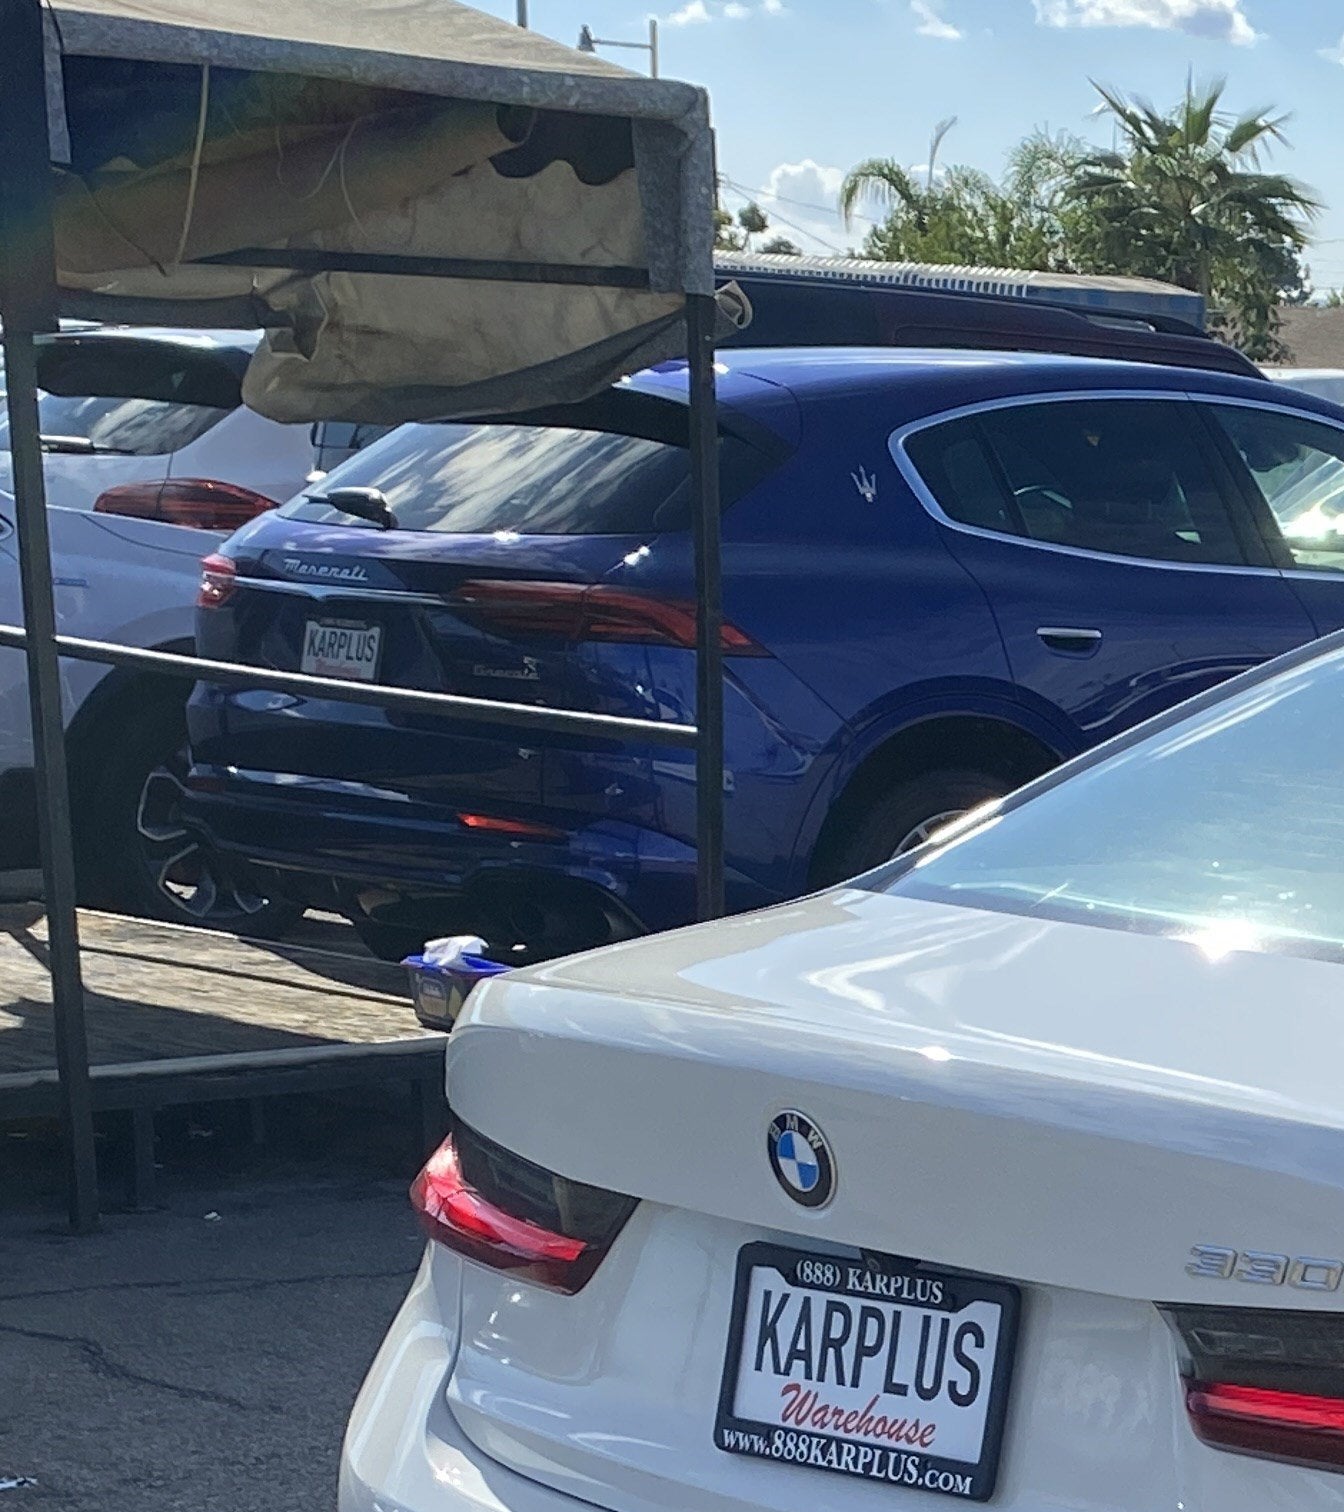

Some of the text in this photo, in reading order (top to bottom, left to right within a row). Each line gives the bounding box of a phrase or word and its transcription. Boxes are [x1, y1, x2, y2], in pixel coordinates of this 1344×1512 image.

[306, 629, 376, 662] KARPLUS
[768, 1113, 823, 1150] BMW
[796, 1259, 944, 1304] (888) KARPLUS
[754, 1288, 985, 1408] KARPLUS
[780, 1383, 936, 1449] Warehouse
